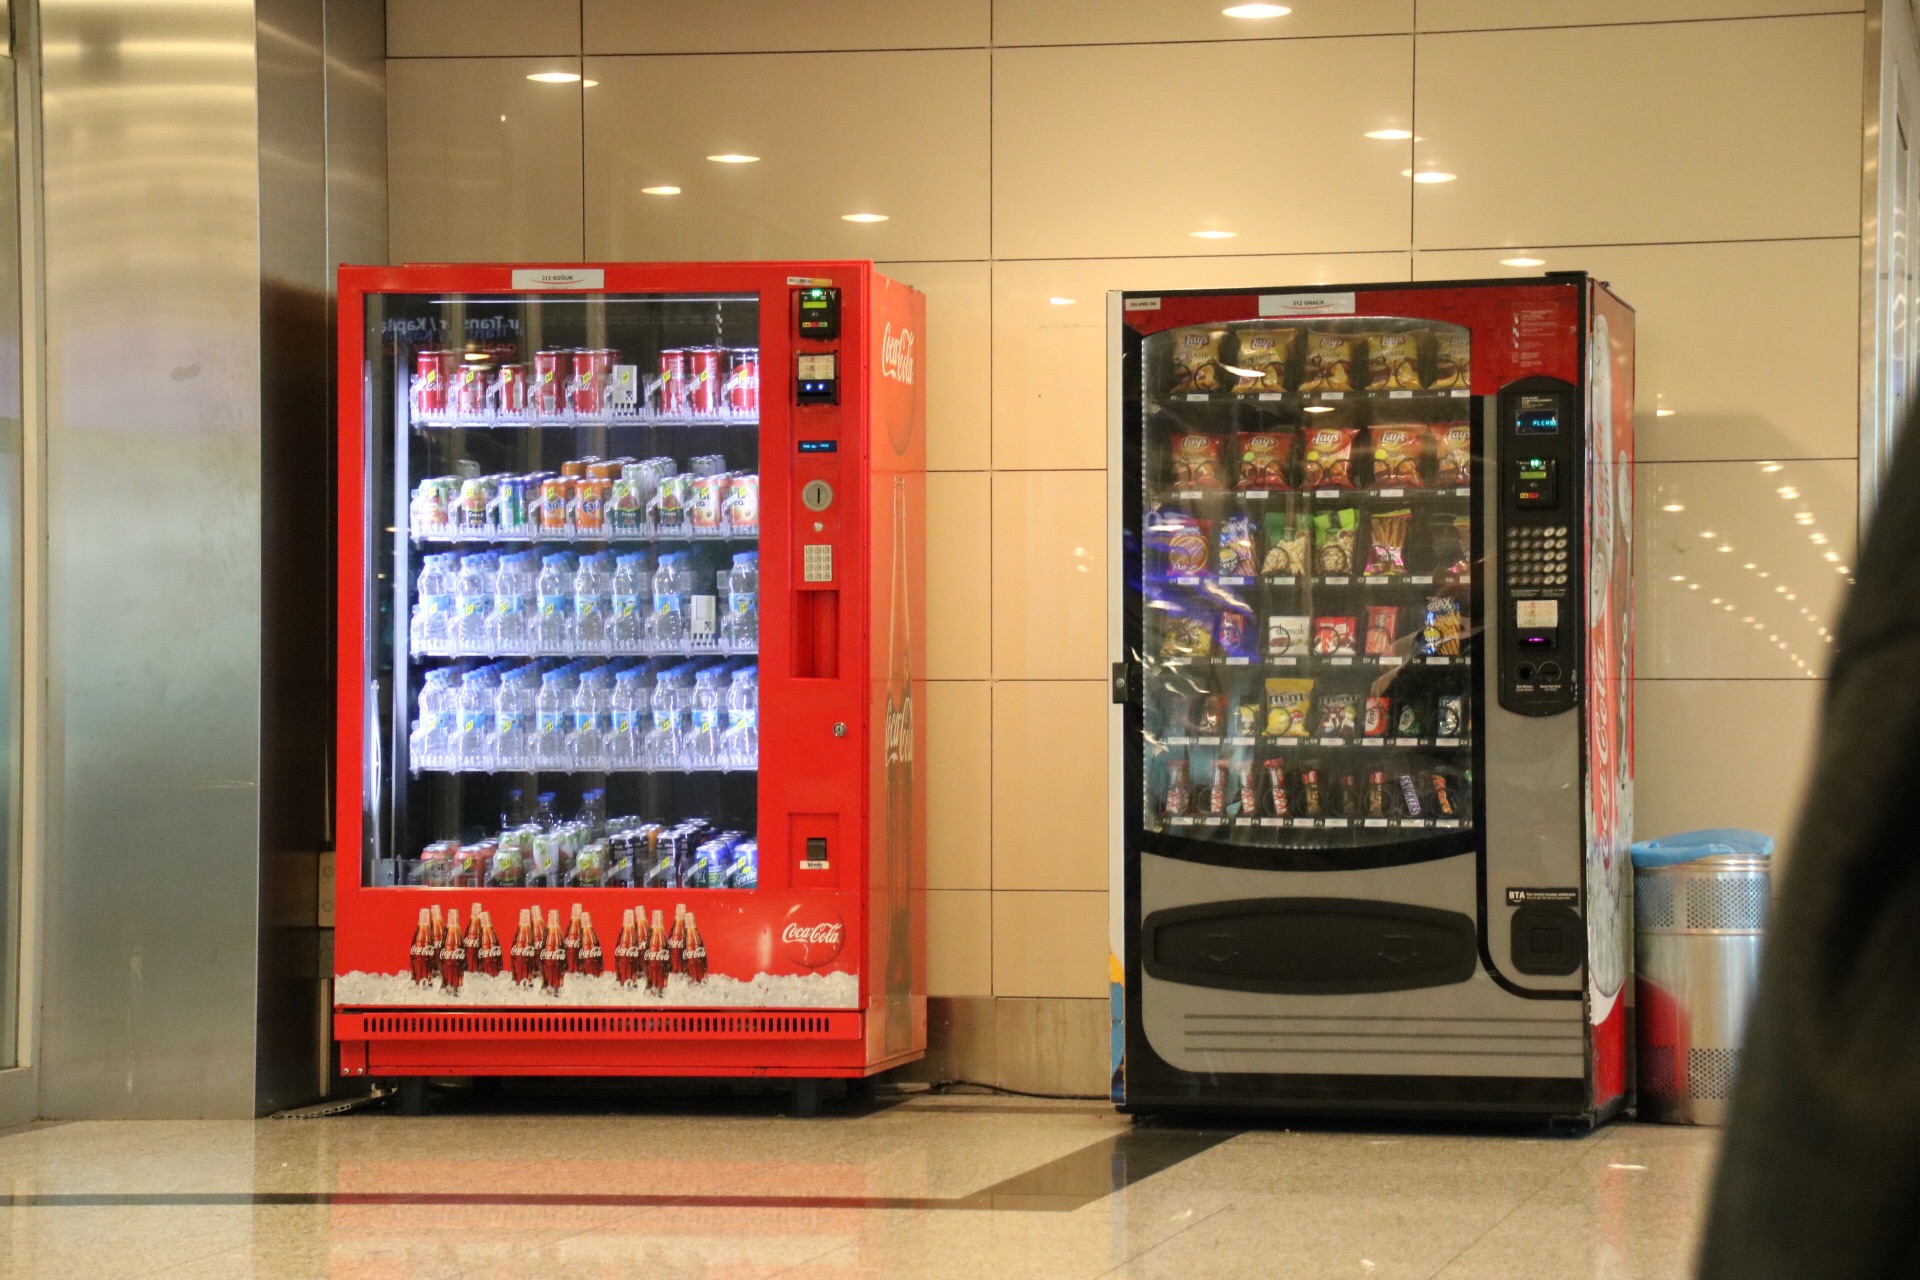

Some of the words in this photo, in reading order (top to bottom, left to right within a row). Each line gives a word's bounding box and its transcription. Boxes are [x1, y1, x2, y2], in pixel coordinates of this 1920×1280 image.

[882, 322, 914, 385] Coca-Cola
[1276, 624, 1305, 636] damak
[1509, 891, 1525, 899] BTA
[782, 923, 842, 943] Coca-Cola
